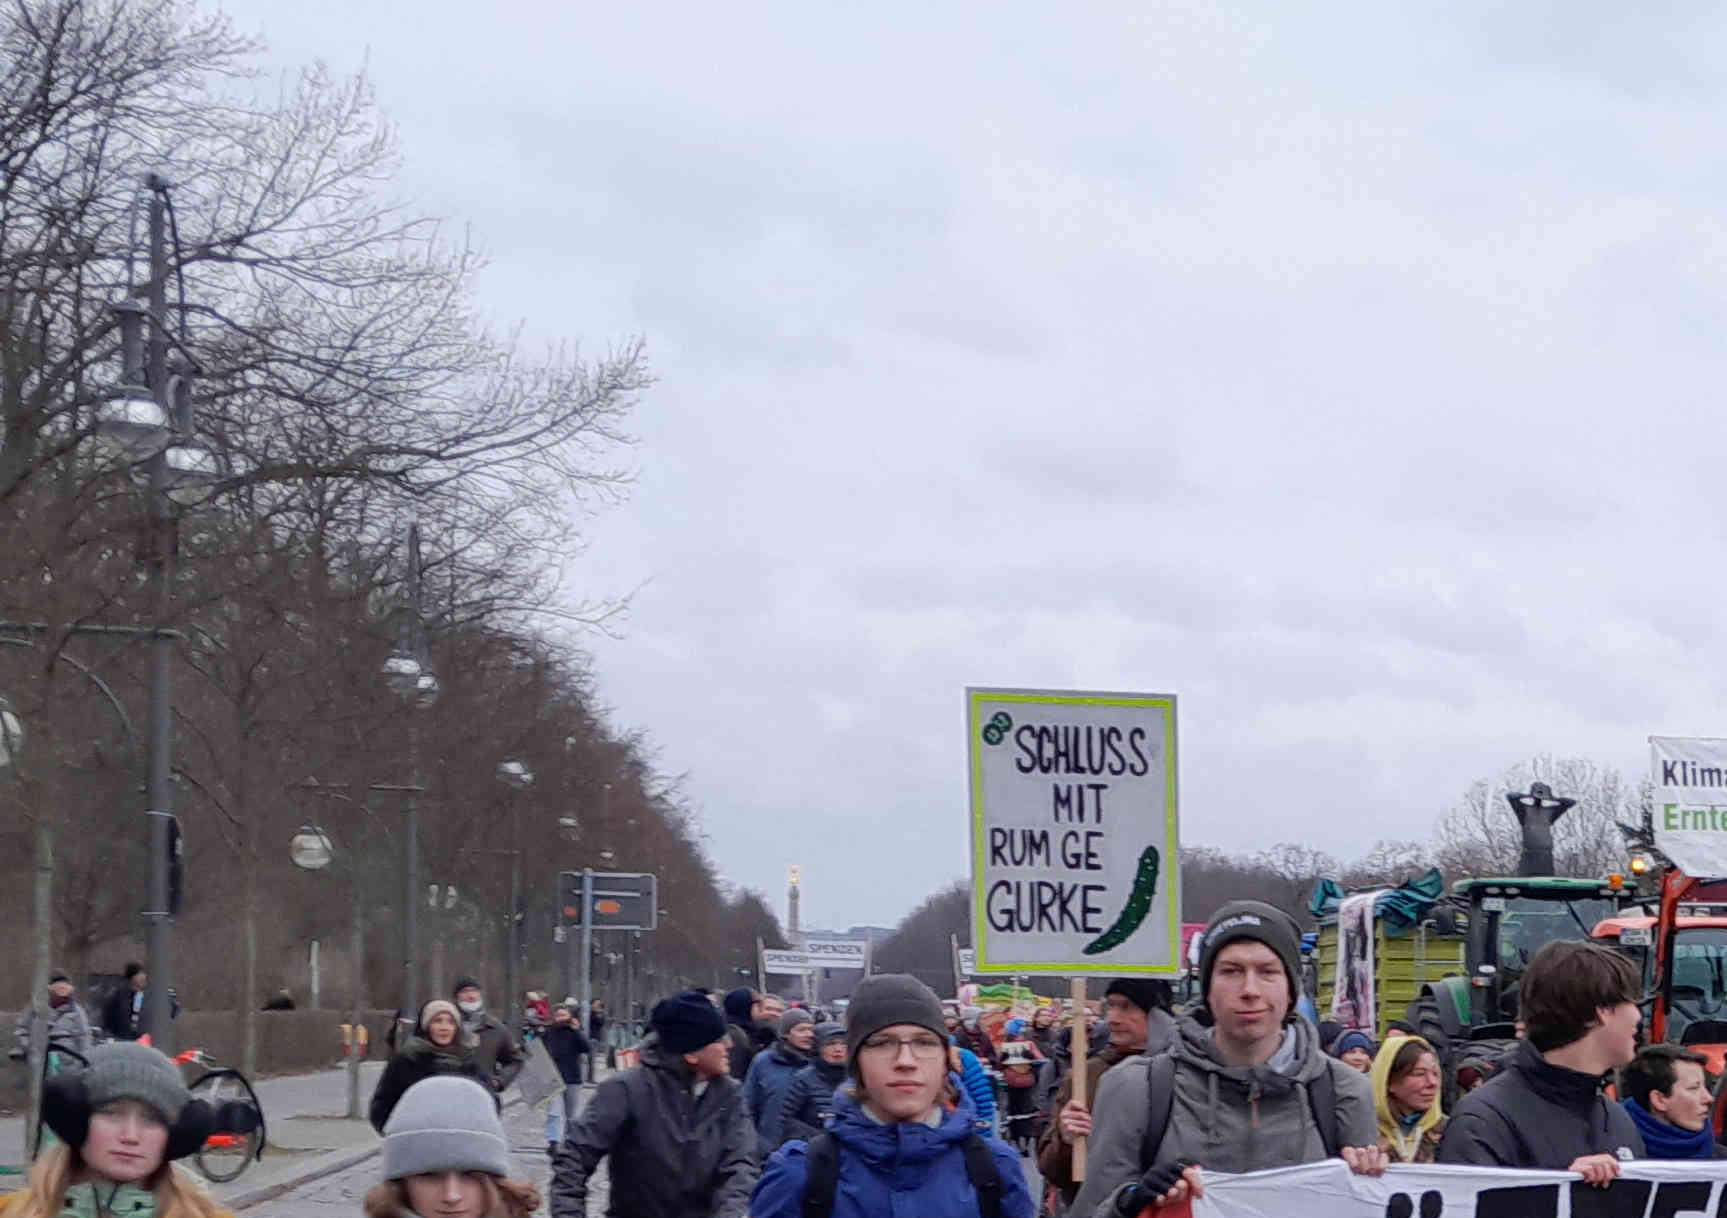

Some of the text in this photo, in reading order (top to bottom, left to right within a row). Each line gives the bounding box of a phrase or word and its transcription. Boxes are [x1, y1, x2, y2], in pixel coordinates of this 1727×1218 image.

[1014, 724, 1150, 777] SCHLUSS
[1052, 783, 1109, 825] MIT
[989, 826, 1105, 872] RUM GE
[986, 879, 1108, 934] GURKE
